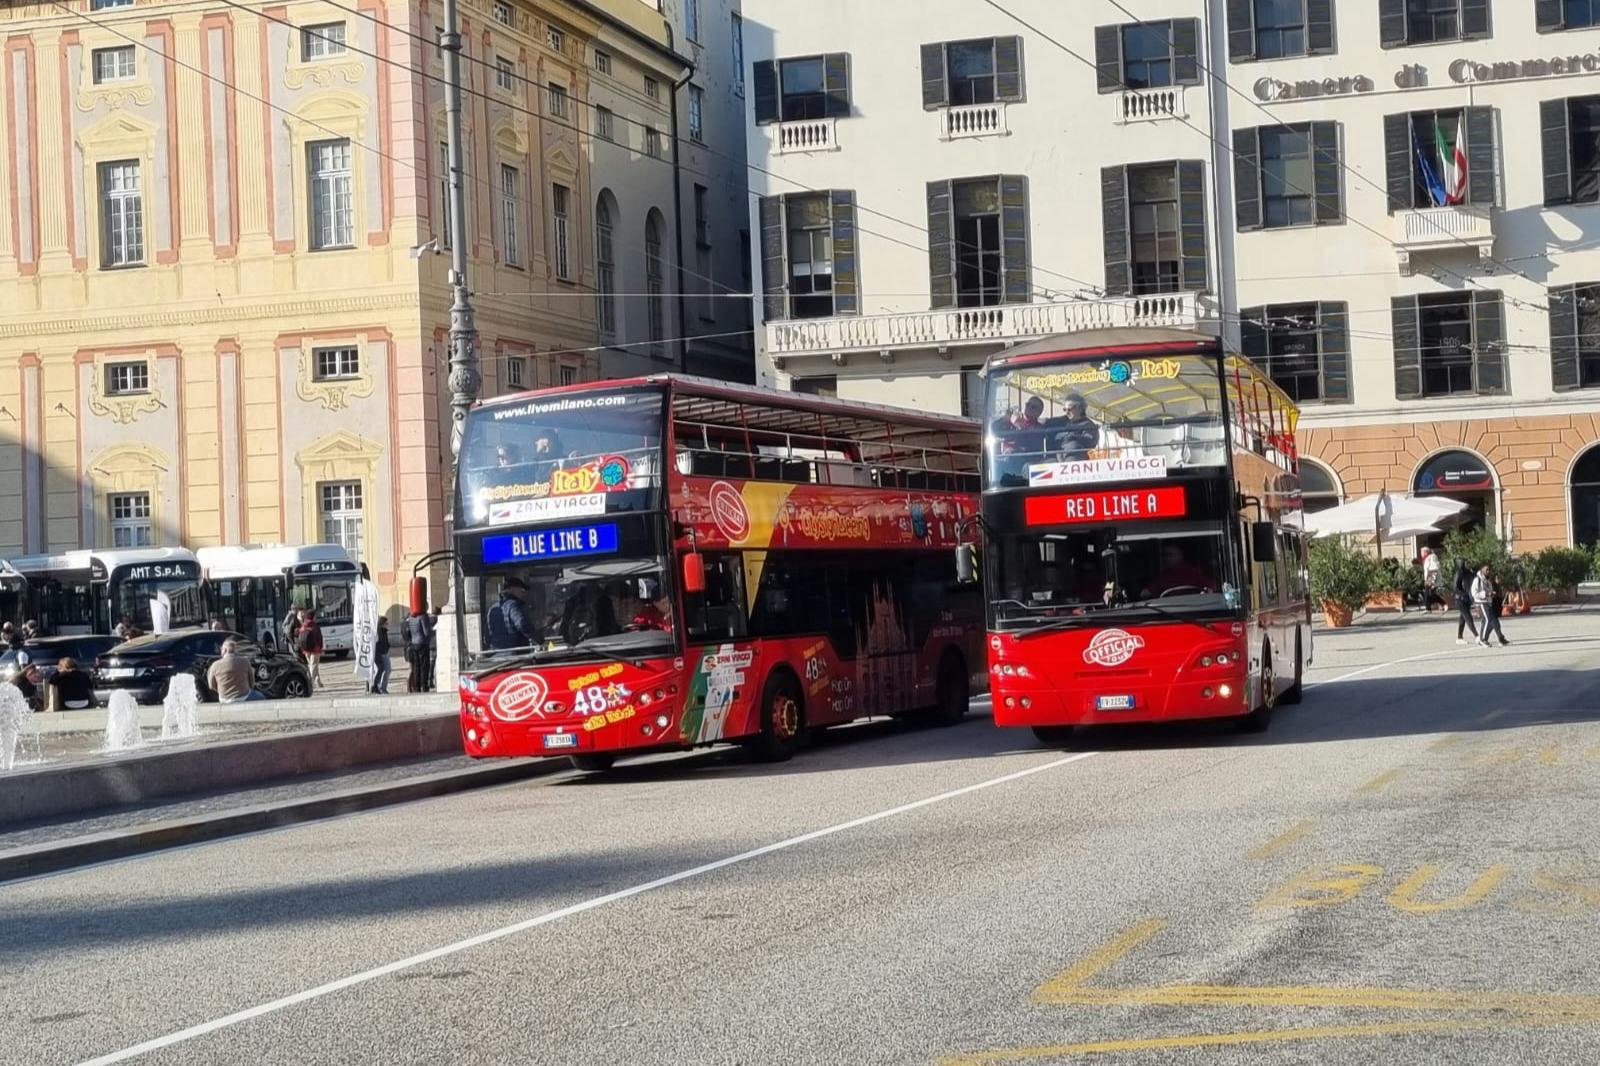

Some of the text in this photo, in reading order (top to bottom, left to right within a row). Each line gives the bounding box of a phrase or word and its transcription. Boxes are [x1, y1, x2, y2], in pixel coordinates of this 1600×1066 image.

[1253, 75, 1371, 100] Camera
[1394, 64, 1426, 87] di
[1141, 359, 1181, 379] Italy
[494, 395, 626, 420] www.livemilano.com
[1060, 457, 1166, 475] ZANI VIAGGI
[552, 467, 600, 494] Italy
[516, 495, 604, 513] ZANI VIAGGI
[1067, 494, 1157, 518] RED LINE A
[512, 528, 598, 556] BLUE LINE B
[130, 564, 186, 579] AMT S.p.A.
[1090, 637, 1139, 660] OFFICIAL
[806, 657, 819, 680] 48
[575, 687, 607, 715] 48
